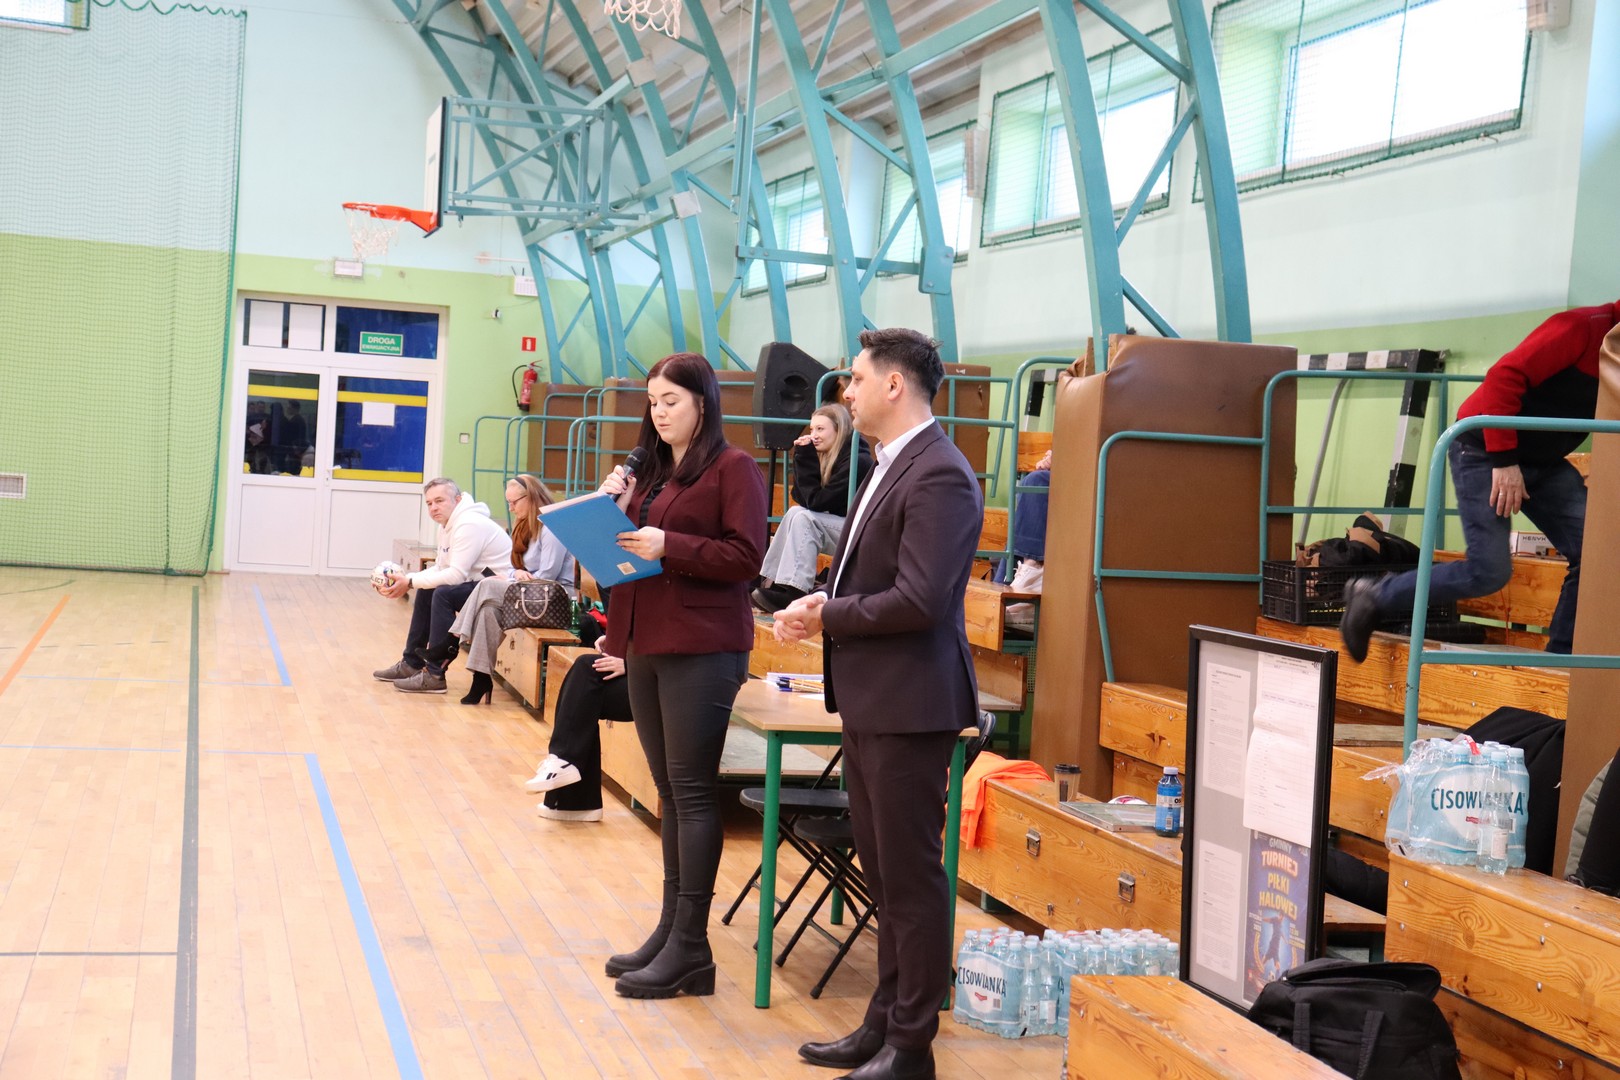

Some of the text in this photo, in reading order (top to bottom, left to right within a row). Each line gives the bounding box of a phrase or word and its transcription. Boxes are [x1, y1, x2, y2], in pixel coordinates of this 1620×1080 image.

[367, 336, 396, 345] DROGA
[1269, 837, 1293, 855] GMINNY
[1261, 850, 1298, 879] TURNIEJ
[1267, 872, 1290, 895] PIŁKI
[1259, 889, 1298, 921] HALOWEJ
[957, 967, 1007, 998] CISOWIANKA
